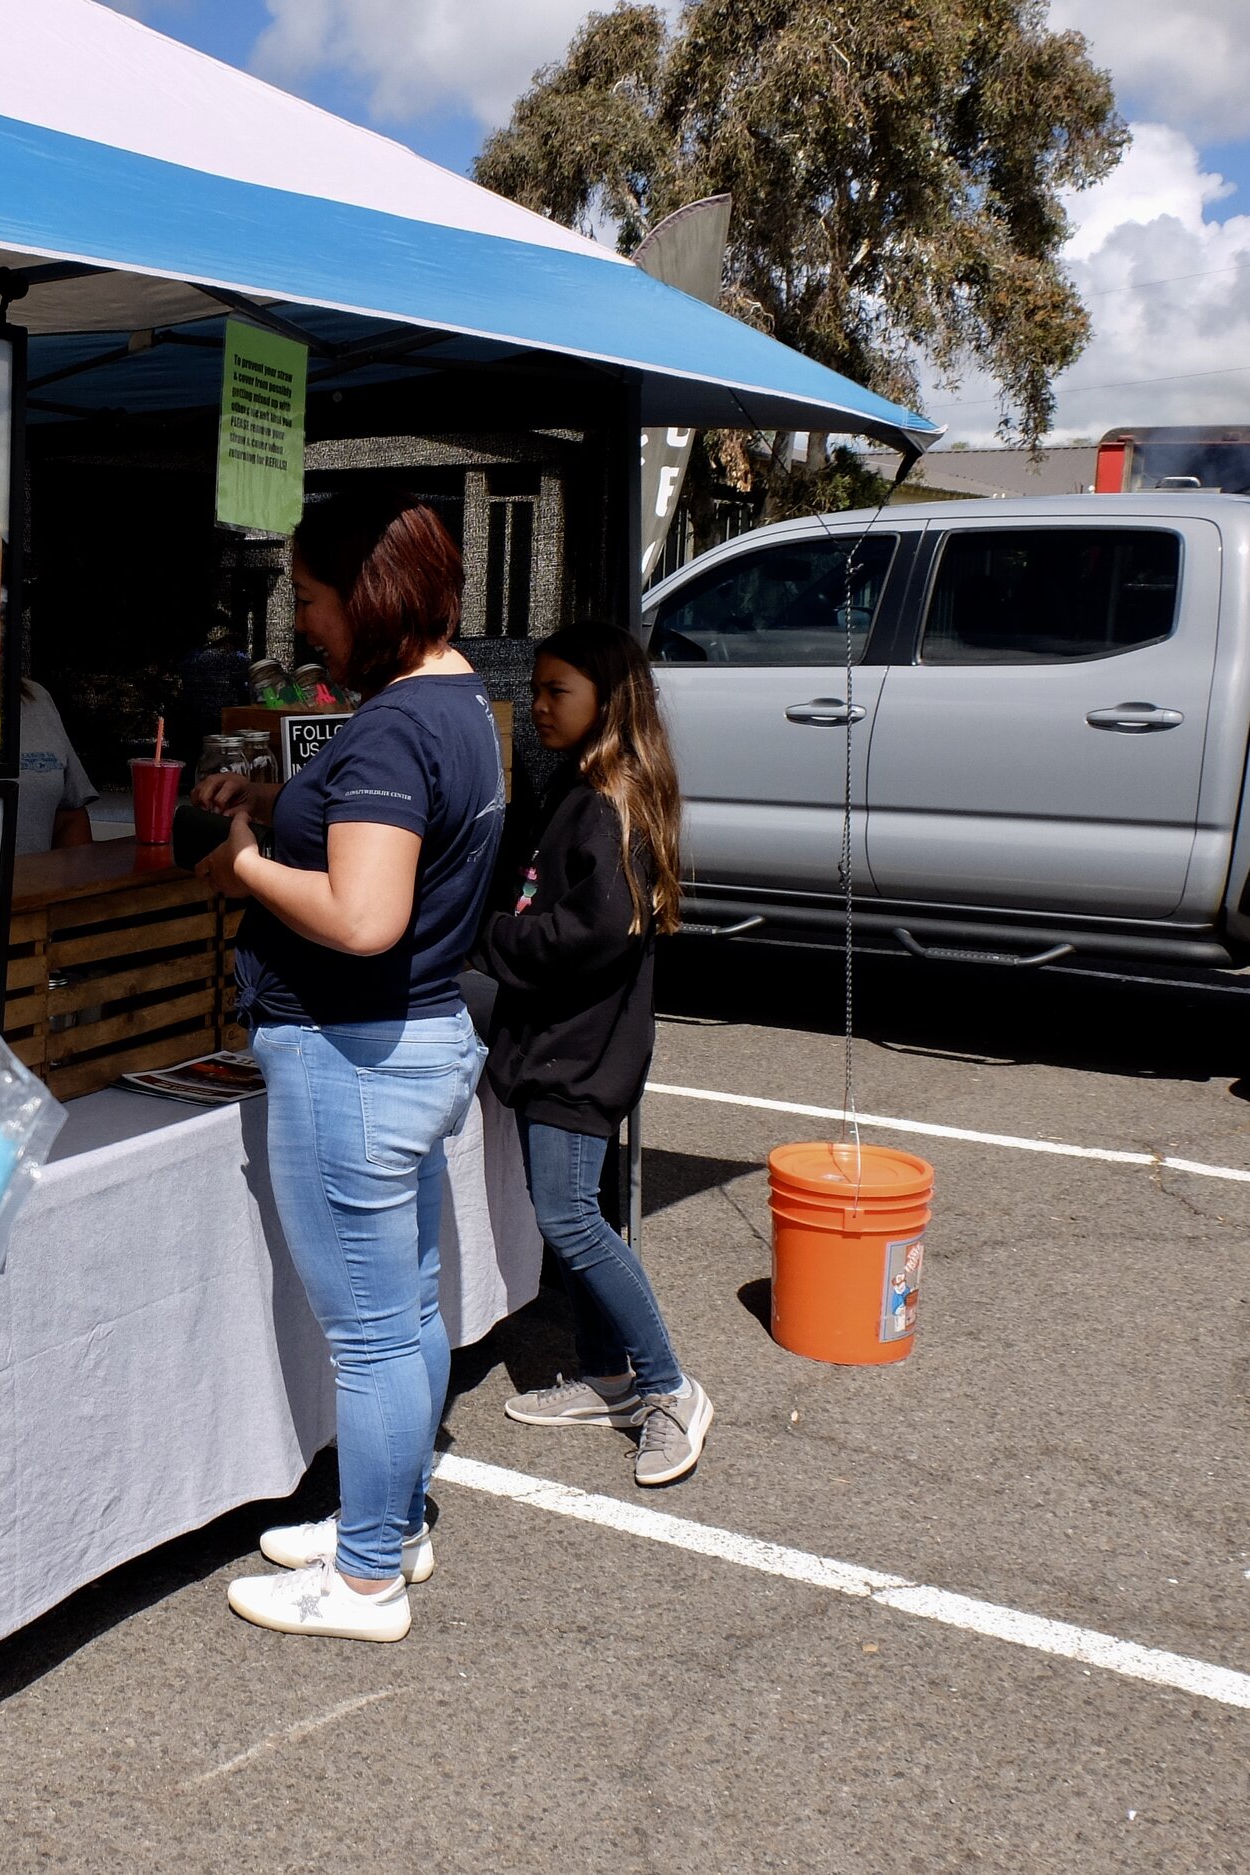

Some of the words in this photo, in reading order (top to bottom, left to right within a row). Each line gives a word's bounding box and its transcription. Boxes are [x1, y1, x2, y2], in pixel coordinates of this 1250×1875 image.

[231, 415, 249, 431] PLEASE
[300, 742, 320, 758] US
[390, 791, 412, 801] CENTER
